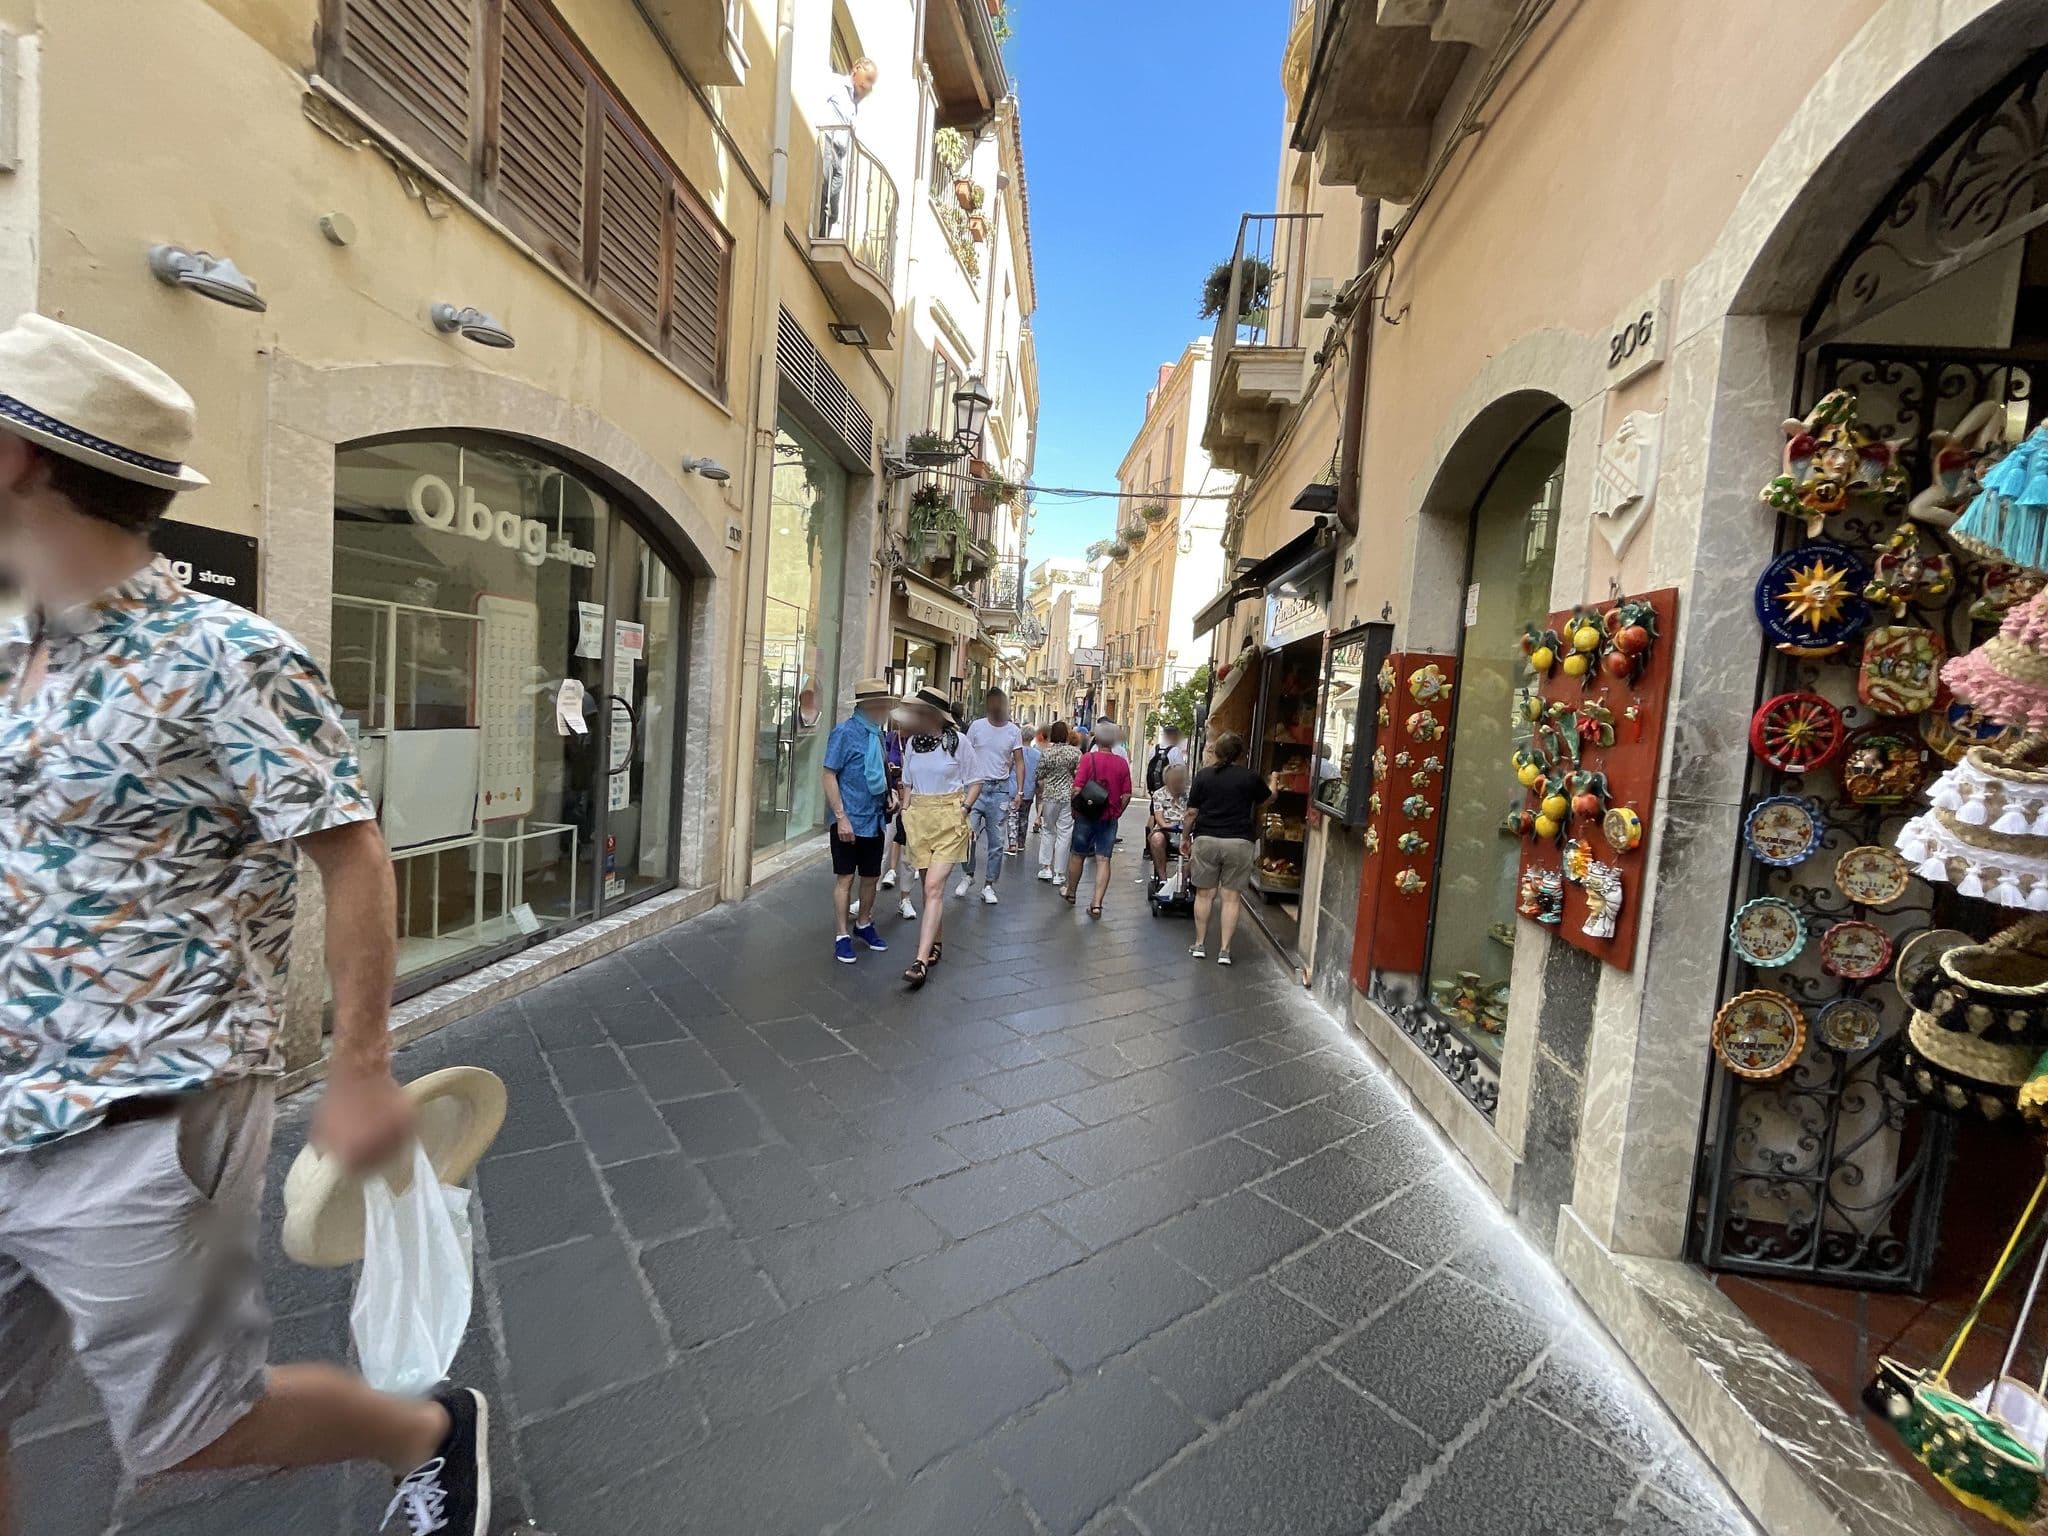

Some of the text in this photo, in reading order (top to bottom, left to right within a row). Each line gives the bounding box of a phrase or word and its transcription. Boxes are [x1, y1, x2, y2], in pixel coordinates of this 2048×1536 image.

[1607, 310, 1654, 371] 206
[407, 474, 455, 530] O
[458, 485, 548, 567] bag
[199, 569, 237, 587] store
